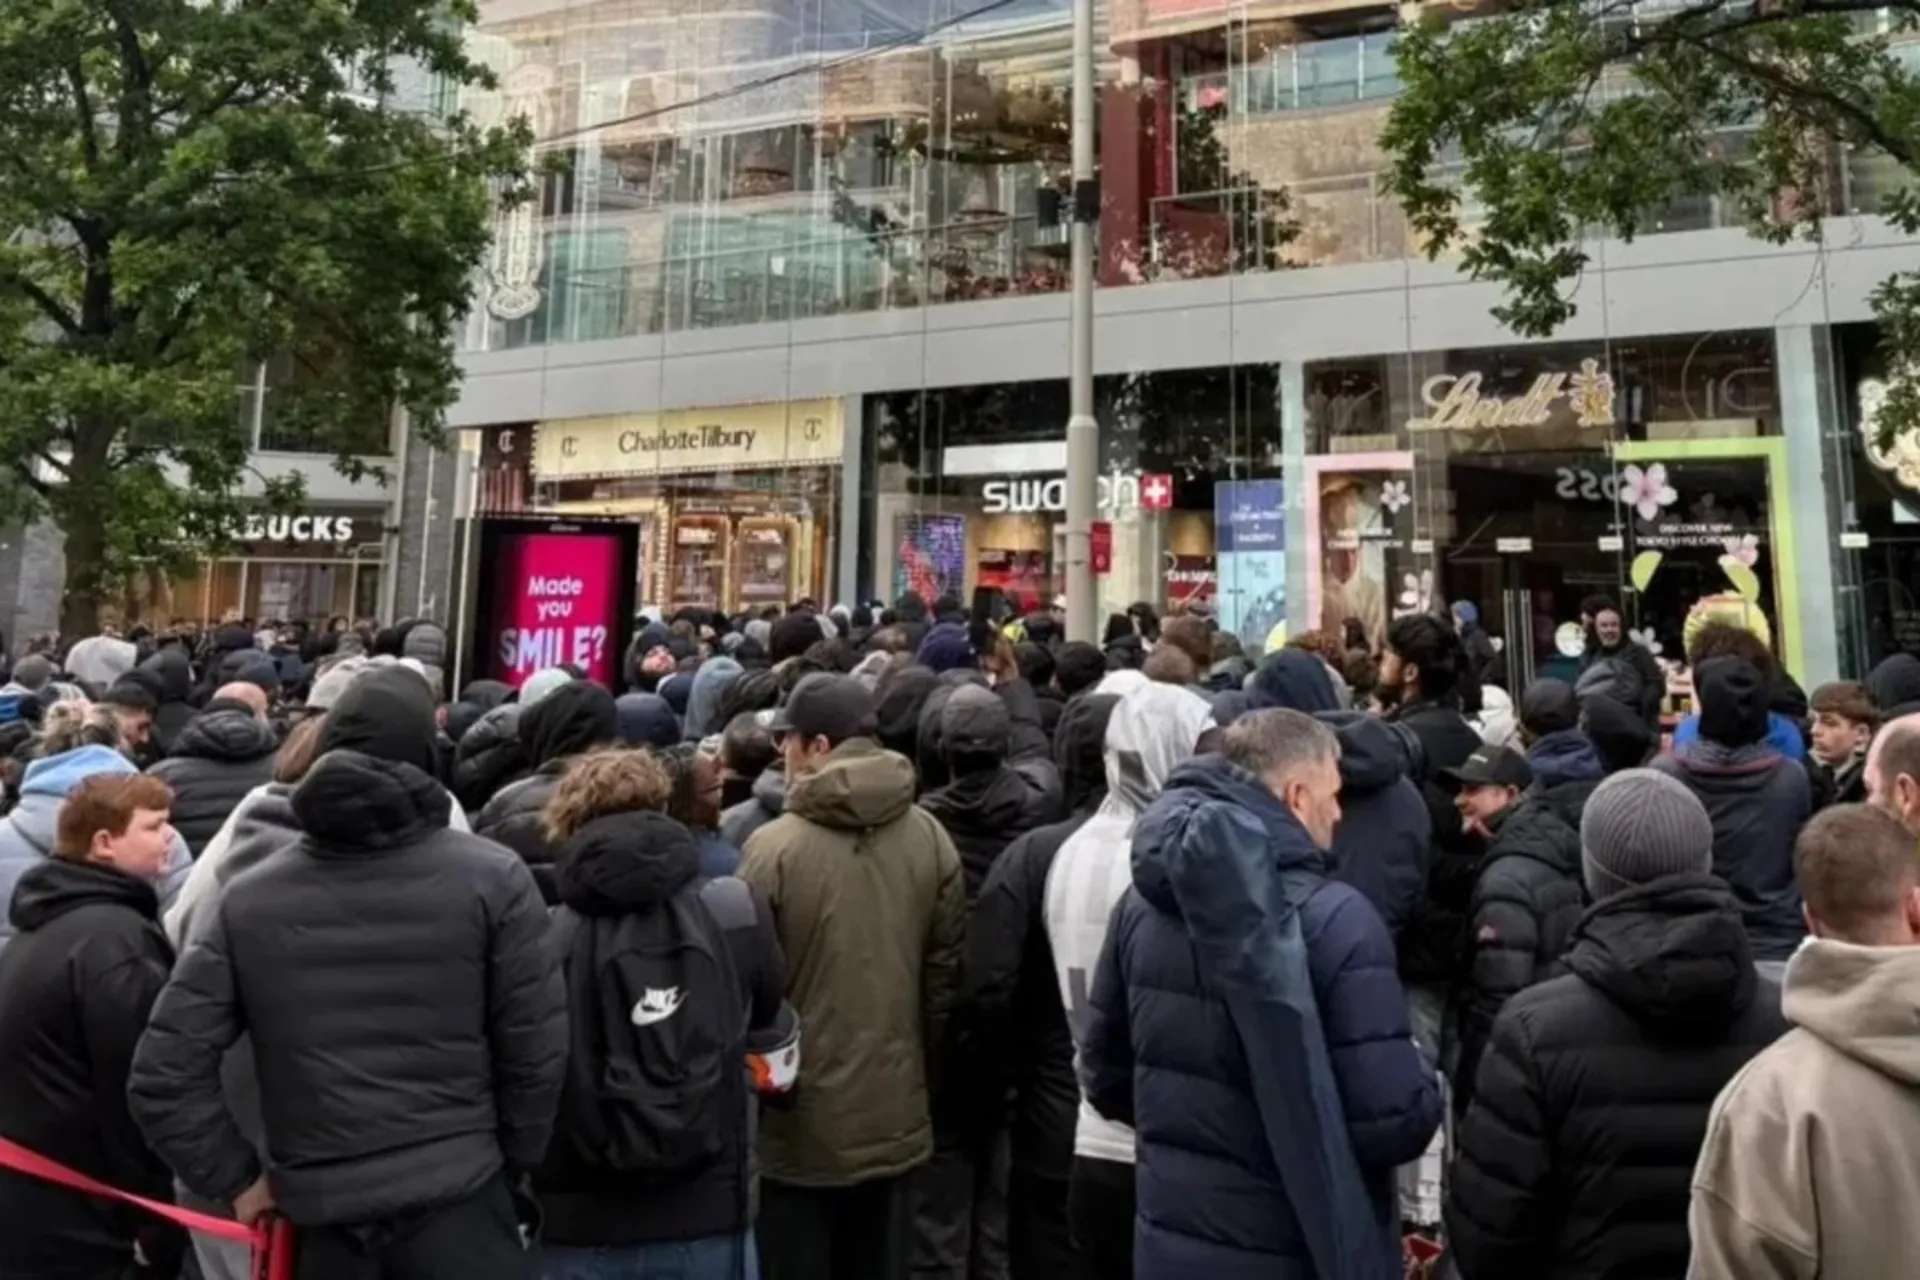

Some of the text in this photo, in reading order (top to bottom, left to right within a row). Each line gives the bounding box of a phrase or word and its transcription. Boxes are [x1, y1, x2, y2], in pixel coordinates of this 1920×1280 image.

[1405, 370, 1567, 431] Lindt
[982, 470, 1140, 513] swah
[528, 576, 584, 597] Made
[536, 601, 573, 622] you
[500, 624, 608, 673] SMILE?
